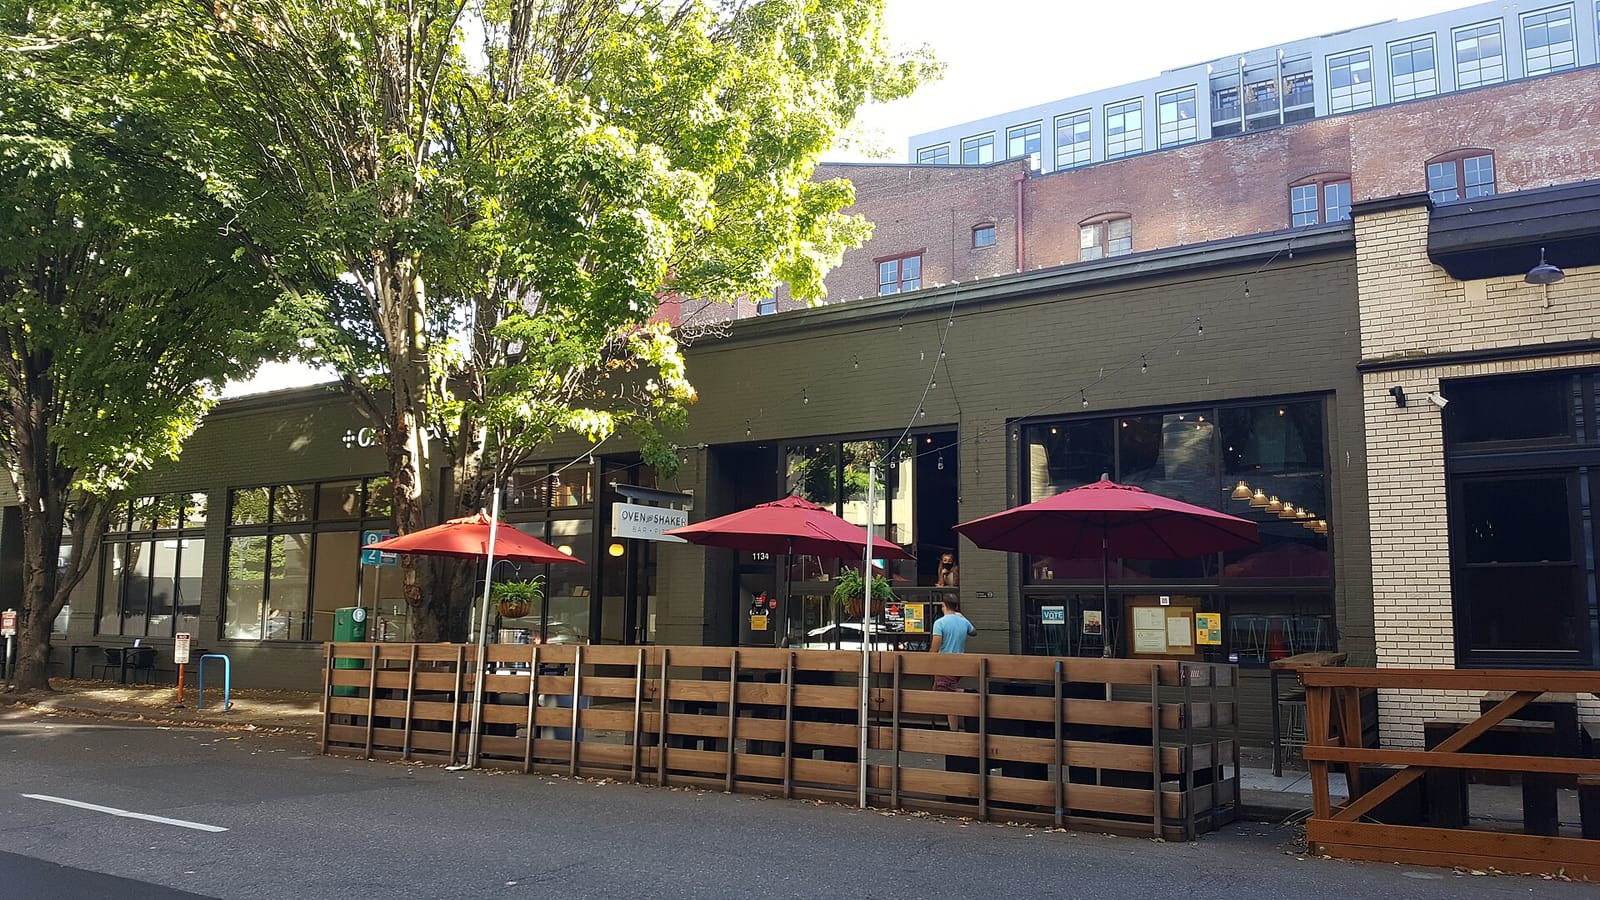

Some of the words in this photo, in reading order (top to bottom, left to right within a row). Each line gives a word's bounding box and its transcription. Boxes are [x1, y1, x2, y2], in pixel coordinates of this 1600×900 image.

[621, 510, 646, 522] OVEN
[653, 513, 687, 527] SHAKER
[752, 552, 769, 560] 1134
[1043, 610, 1064, 620] VOTE
